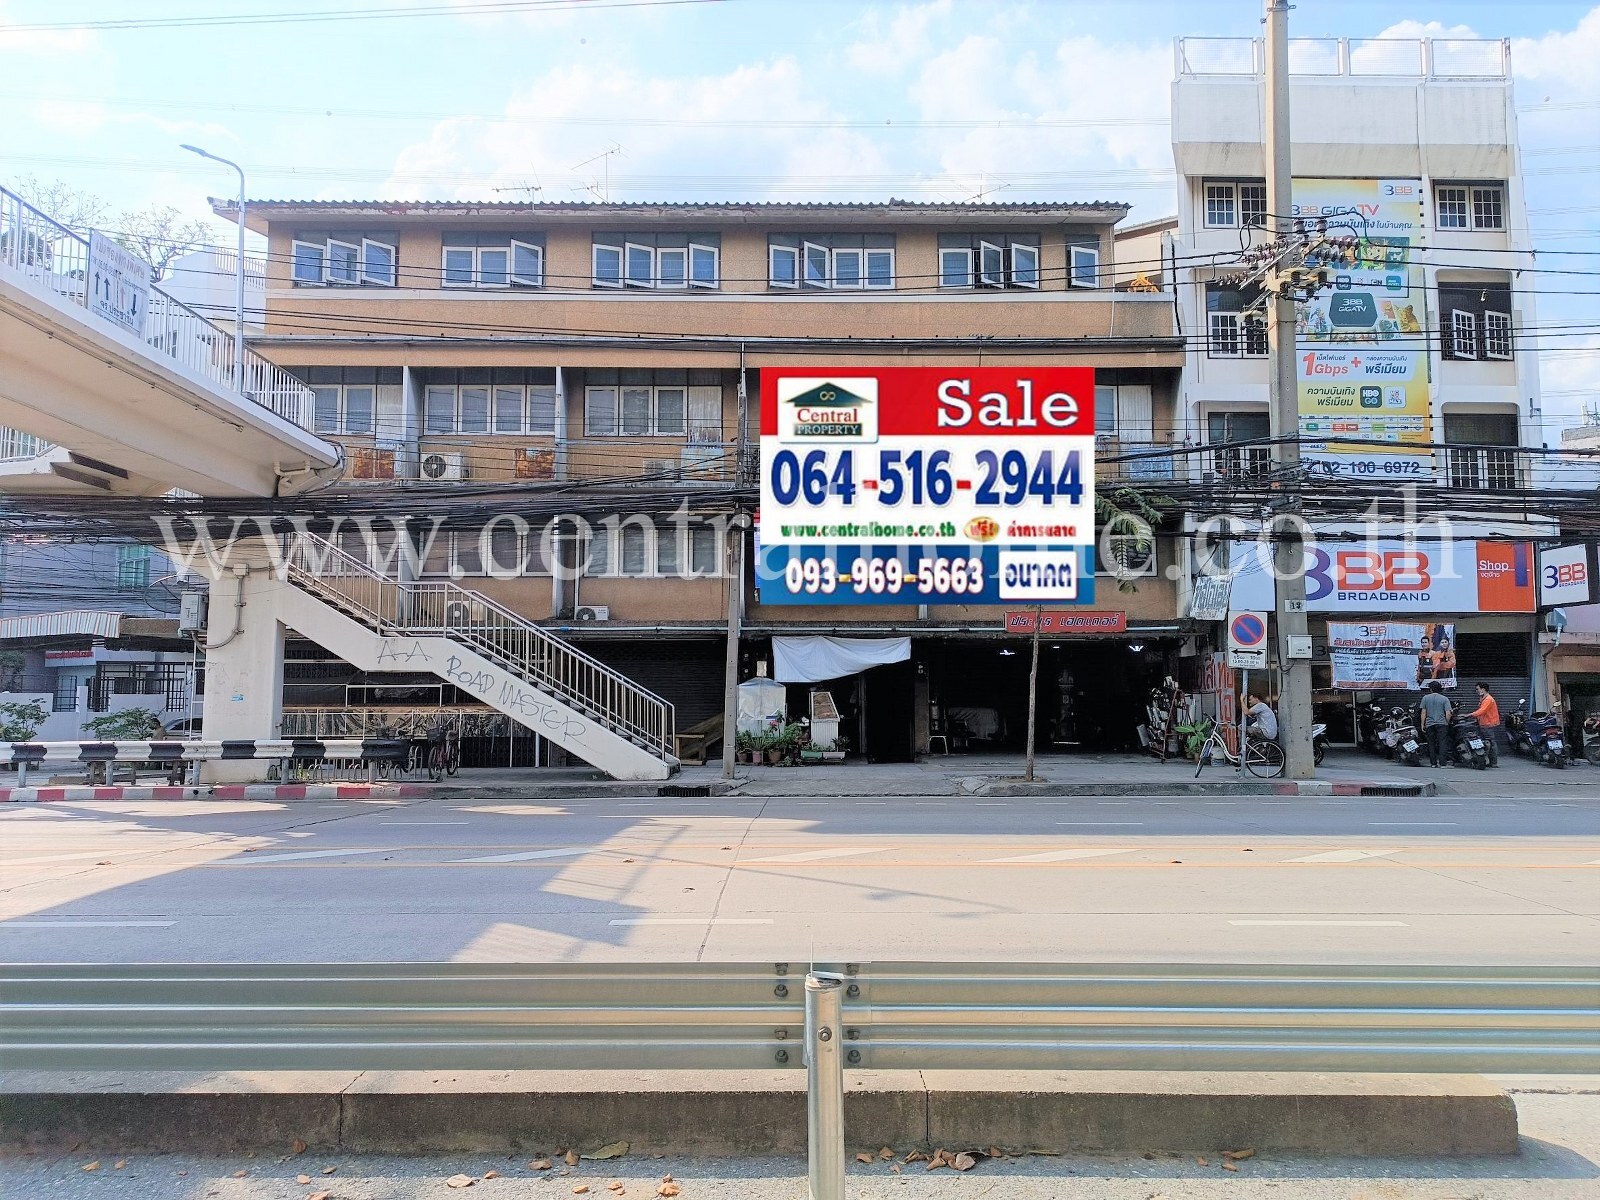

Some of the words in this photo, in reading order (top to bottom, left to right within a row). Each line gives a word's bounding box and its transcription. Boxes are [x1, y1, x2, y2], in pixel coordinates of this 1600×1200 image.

[1384, 185, 1413, 195] 3BB
[1342, 298, 1364, 306] 3BB
[1307, 386, 1355, 396] ความบันเทิง
[1362, 389, 1379, 397] HBO
[1364, 397, 1378, 405] GO
[1322, 461, 1420, 474] 02-100-6972
[1479, 560, 1509, 573] Shop
[1543, 563, 1586, 589] 3BB
[1338, 592, 1430, 601] BROADBAND
[1359, 626, 1386, 637] 3BB
[446, 655, 495, 694] ROAD
[499, 680, 587, 747] MASTER
